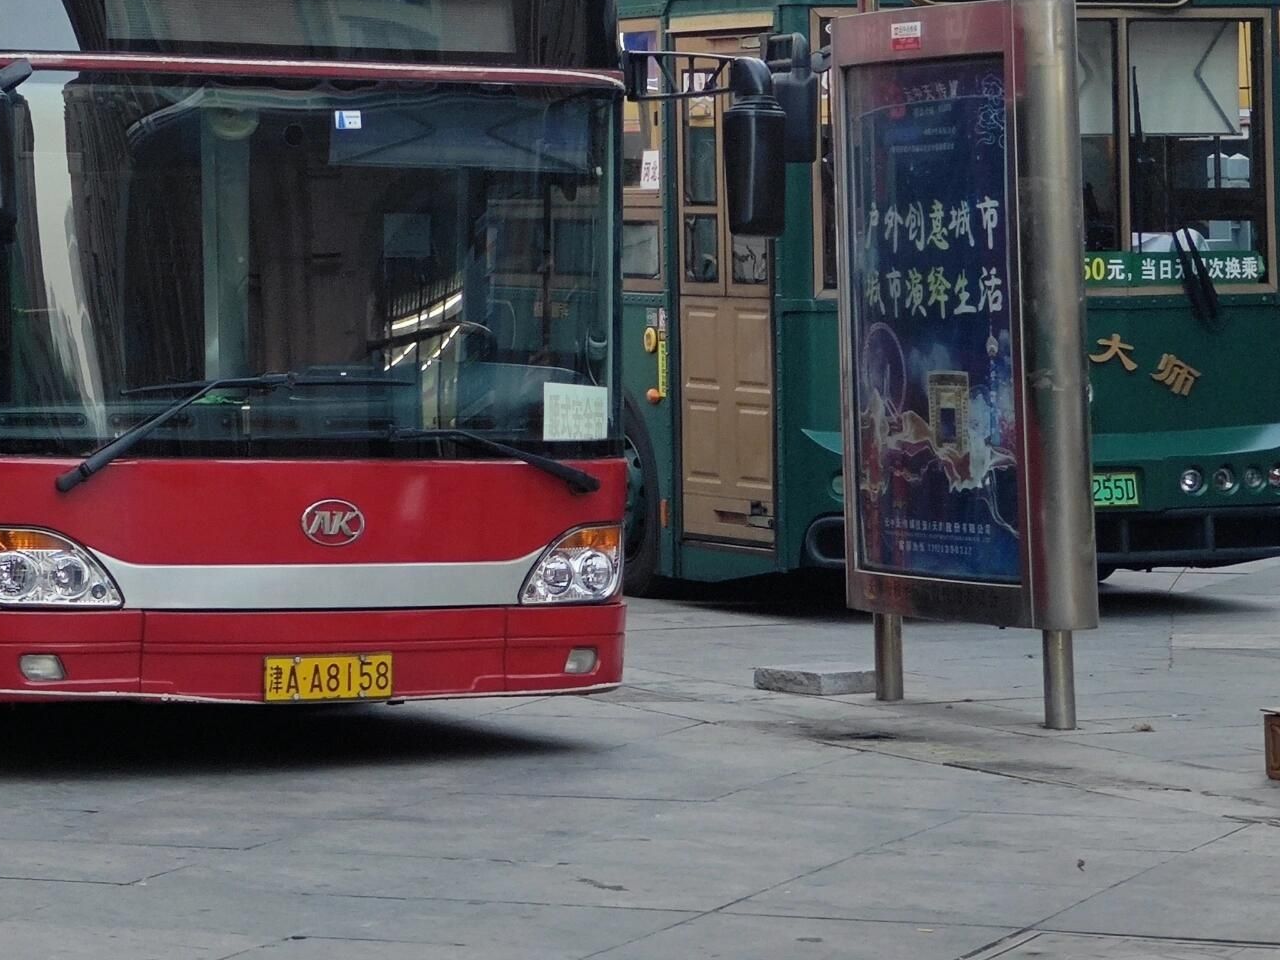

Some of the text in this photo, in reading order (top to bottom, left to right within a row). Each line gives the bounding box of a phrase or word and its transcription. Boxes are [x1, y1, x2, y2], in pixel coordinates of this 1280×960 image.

[865, 195, 1000, 253] 户外创意城市
[866, 266, 1003, 319] 城市演绎生活
[1089, 333, 1203, 397] 大师
